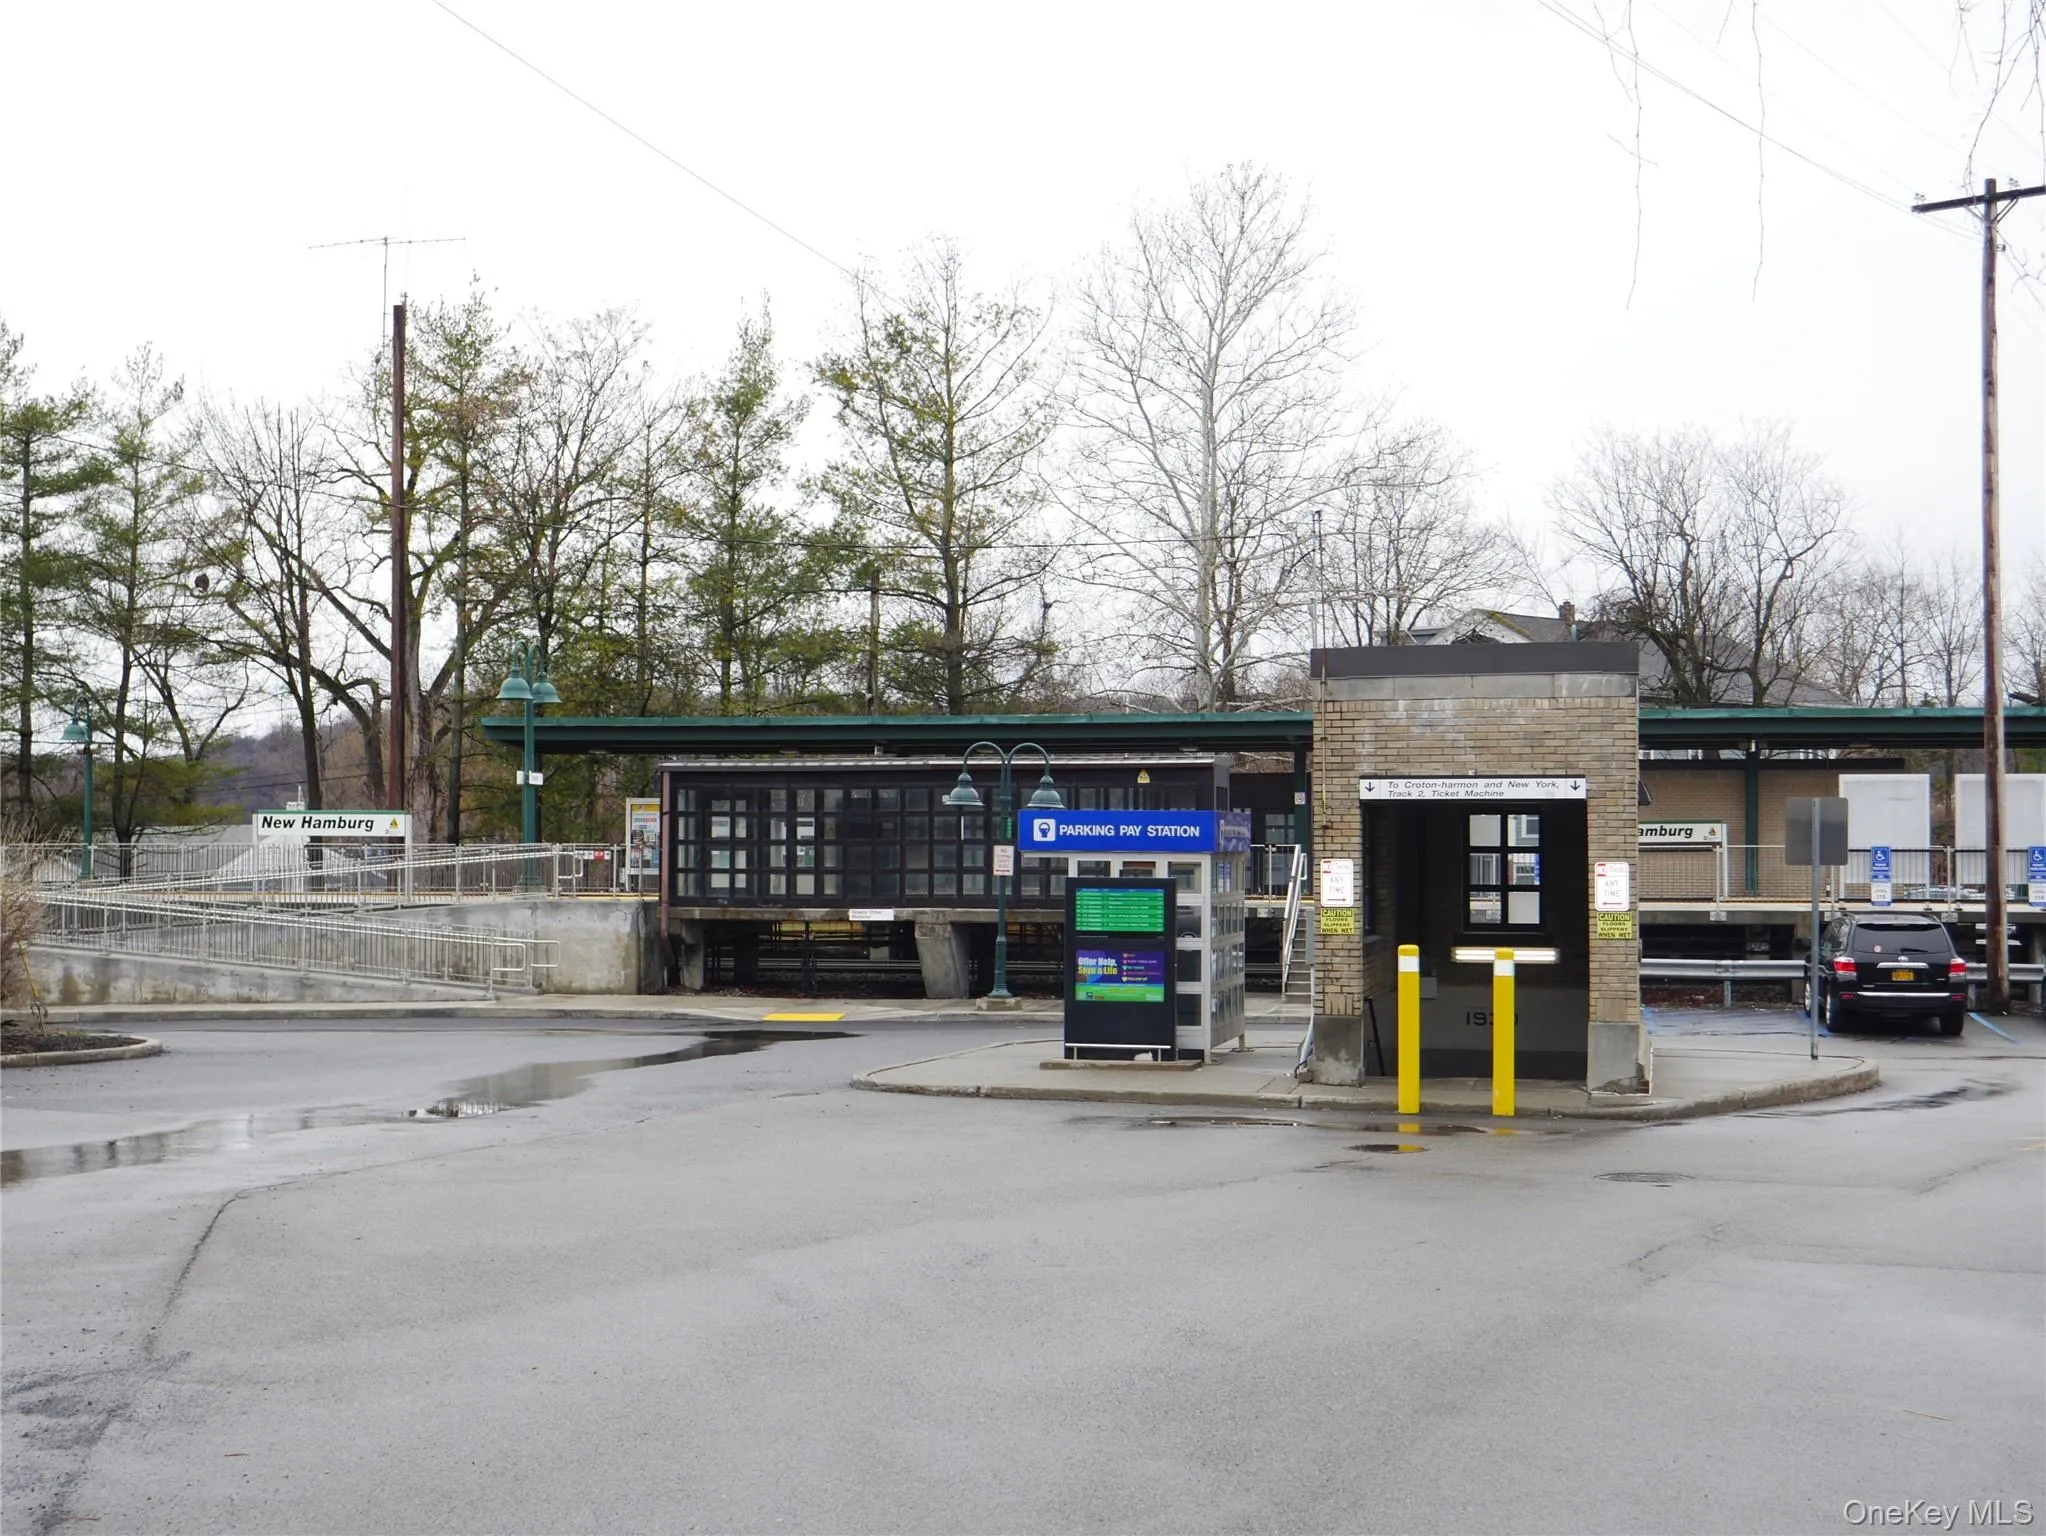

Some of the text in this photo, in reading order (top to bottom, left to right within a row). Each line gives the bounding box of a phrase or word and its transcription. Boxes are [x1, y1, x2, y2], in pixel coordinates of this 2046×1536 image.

[1388, 781, 1560, 790] To Croton-harmon and New York,
[1417, 790, 1426, 799] 2,
[1432, 790, 1457, 798] Ticket
[1464, 790, 1505, 798] Machine
[261, 815, 375, 832] New Hamburg
[1059, 824, 1200, 838] PARKING PAY STATION
[1638, 825, 1694, 839] amburg
[1329, 886, 1345, 894] TIME
[1322, 909, 1352, 917] CAUTION
[1599, 913, 1630, 921] CAUTION
